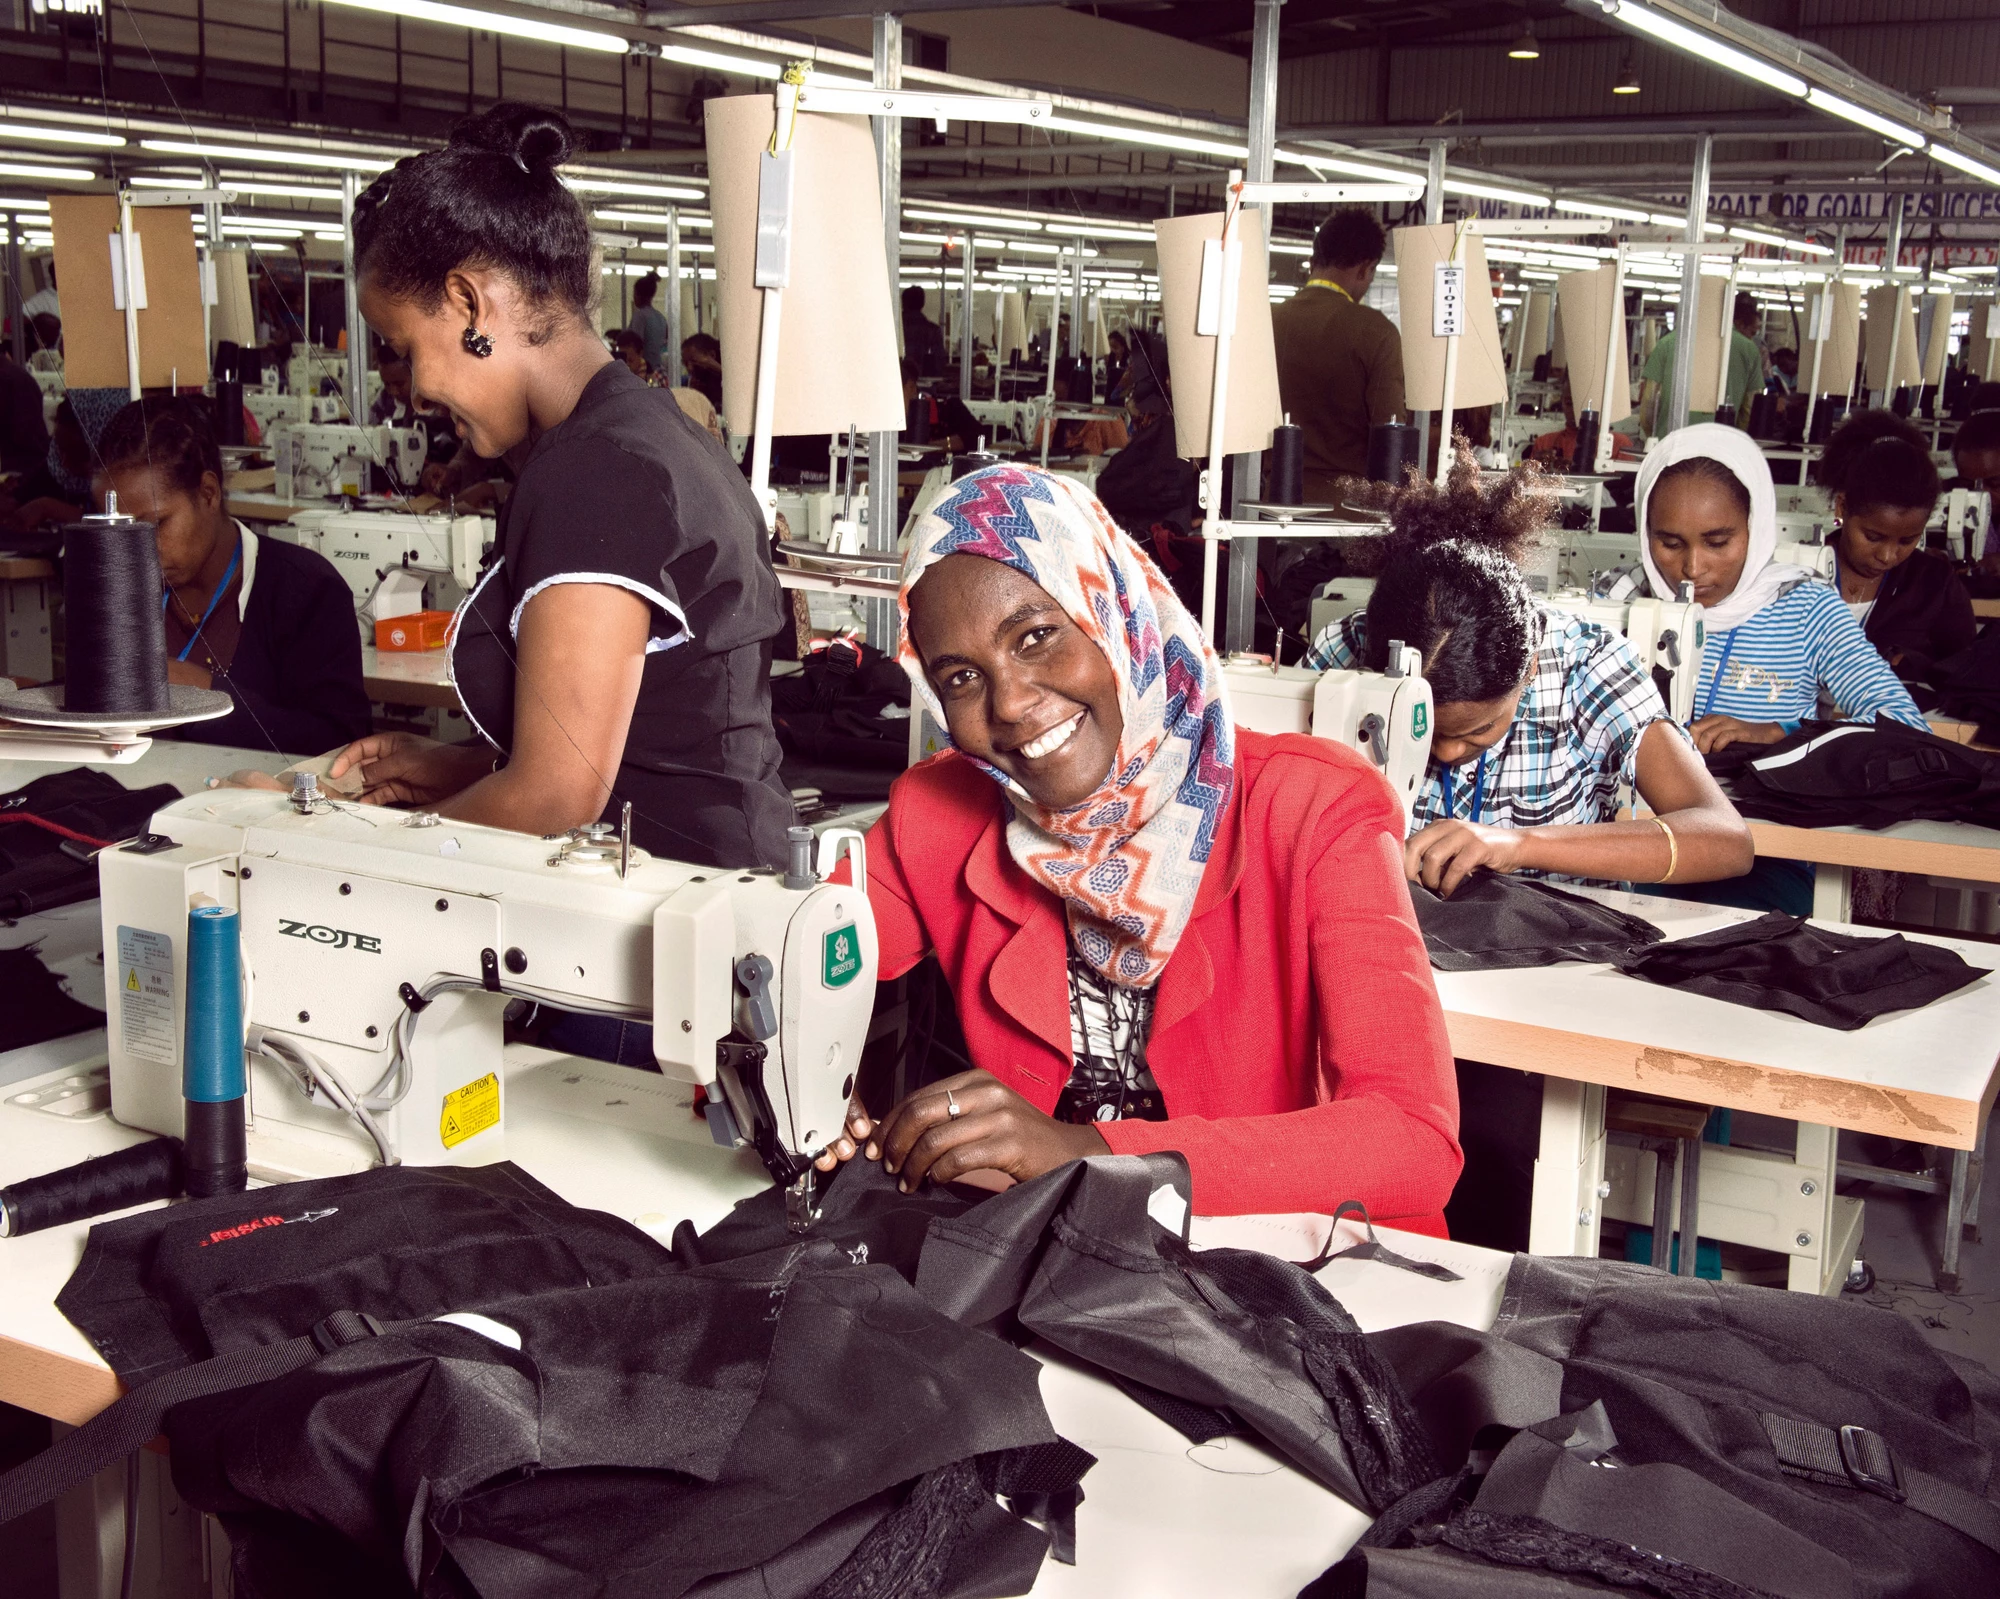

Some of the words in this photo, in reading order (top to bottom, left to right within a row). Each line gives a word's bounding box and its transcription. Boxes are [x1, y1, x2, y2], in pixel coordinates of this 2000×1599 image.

[1768, 194, 1809, 217] OR
[334, 550, 370, 560] ZOJE
[278, 918, 382, 955] ZOJE
[460, 1076, 489, 1099] CAUTION
